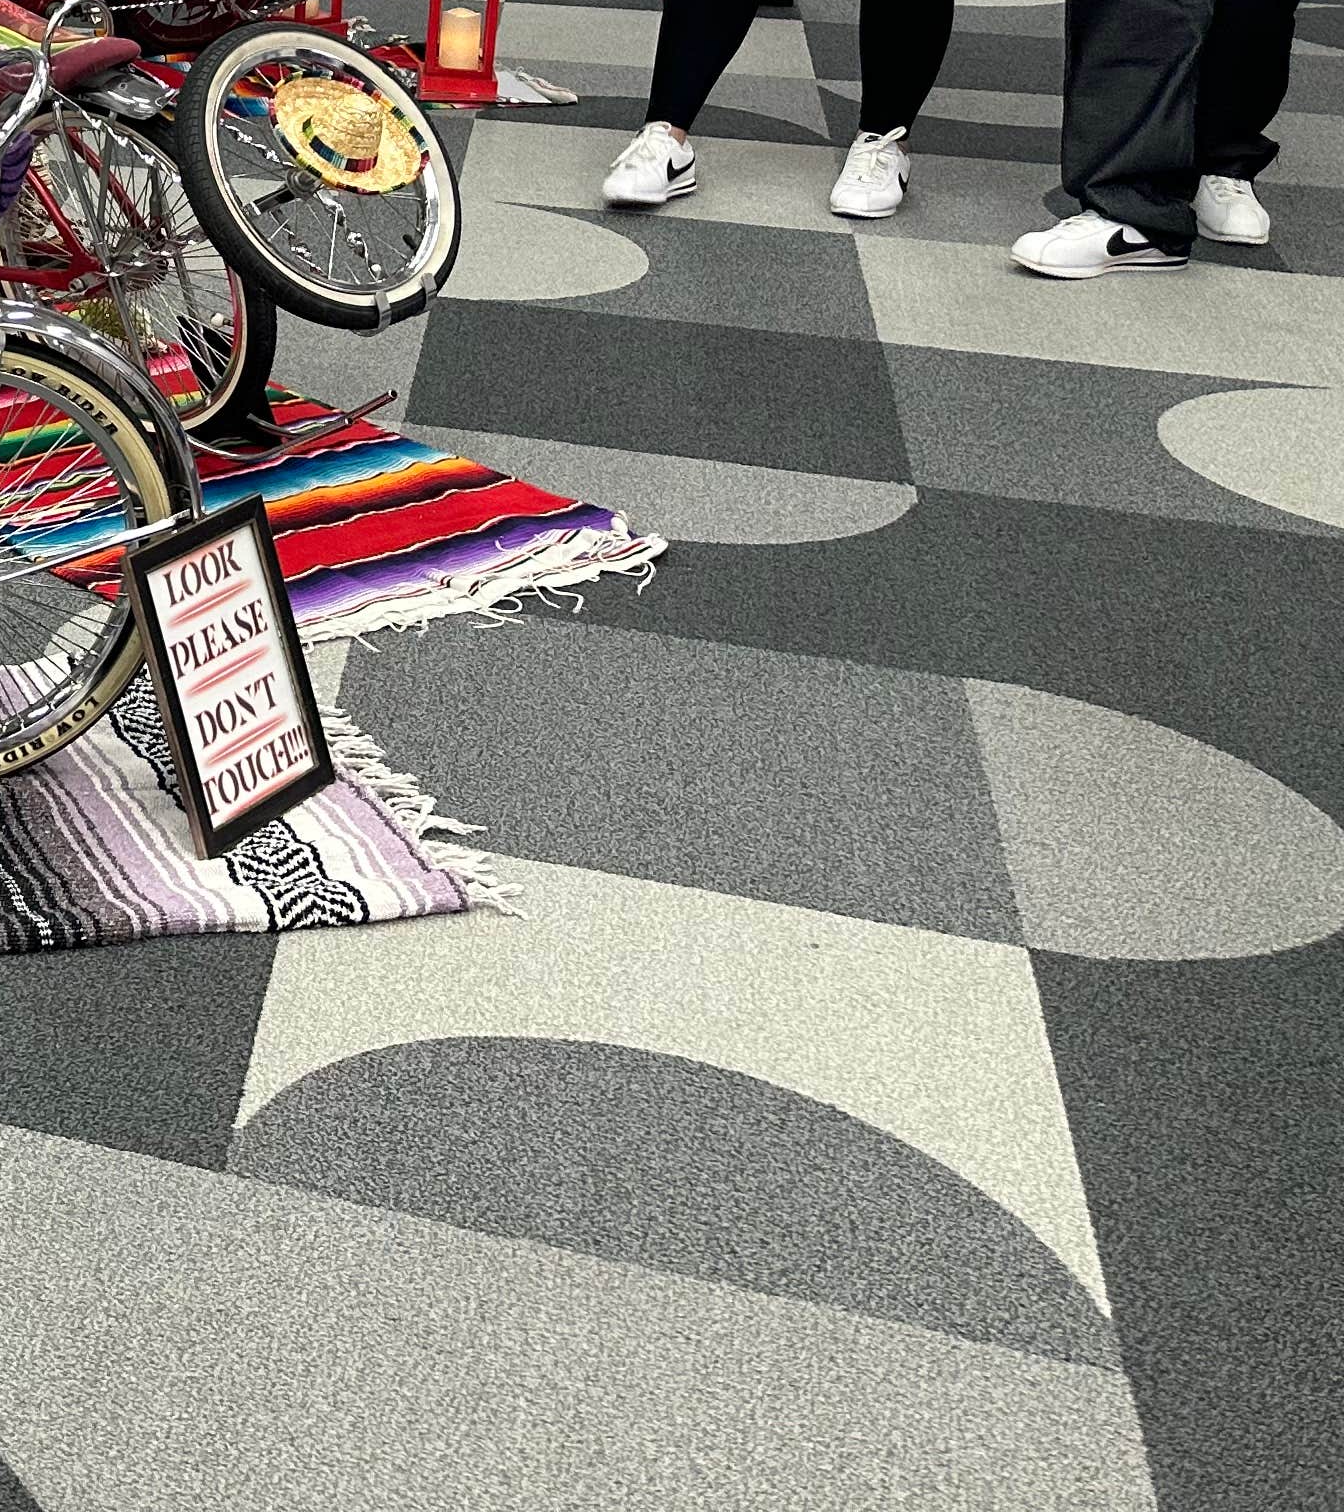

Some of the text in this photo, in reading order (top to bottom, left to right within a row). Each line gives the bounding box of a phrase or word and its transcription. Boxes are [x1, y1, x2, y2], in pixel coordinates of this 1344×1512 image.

[57, 383, 119, 437] RIDER
[162, 540, 243, 608] LOOK
[169, 598, 269, 679] PLEASE
[57, 696, 100, 736] LOW
[194, 671, 278, 749] DON'T
[203, 724, 310, 815] TOUCH!!!
